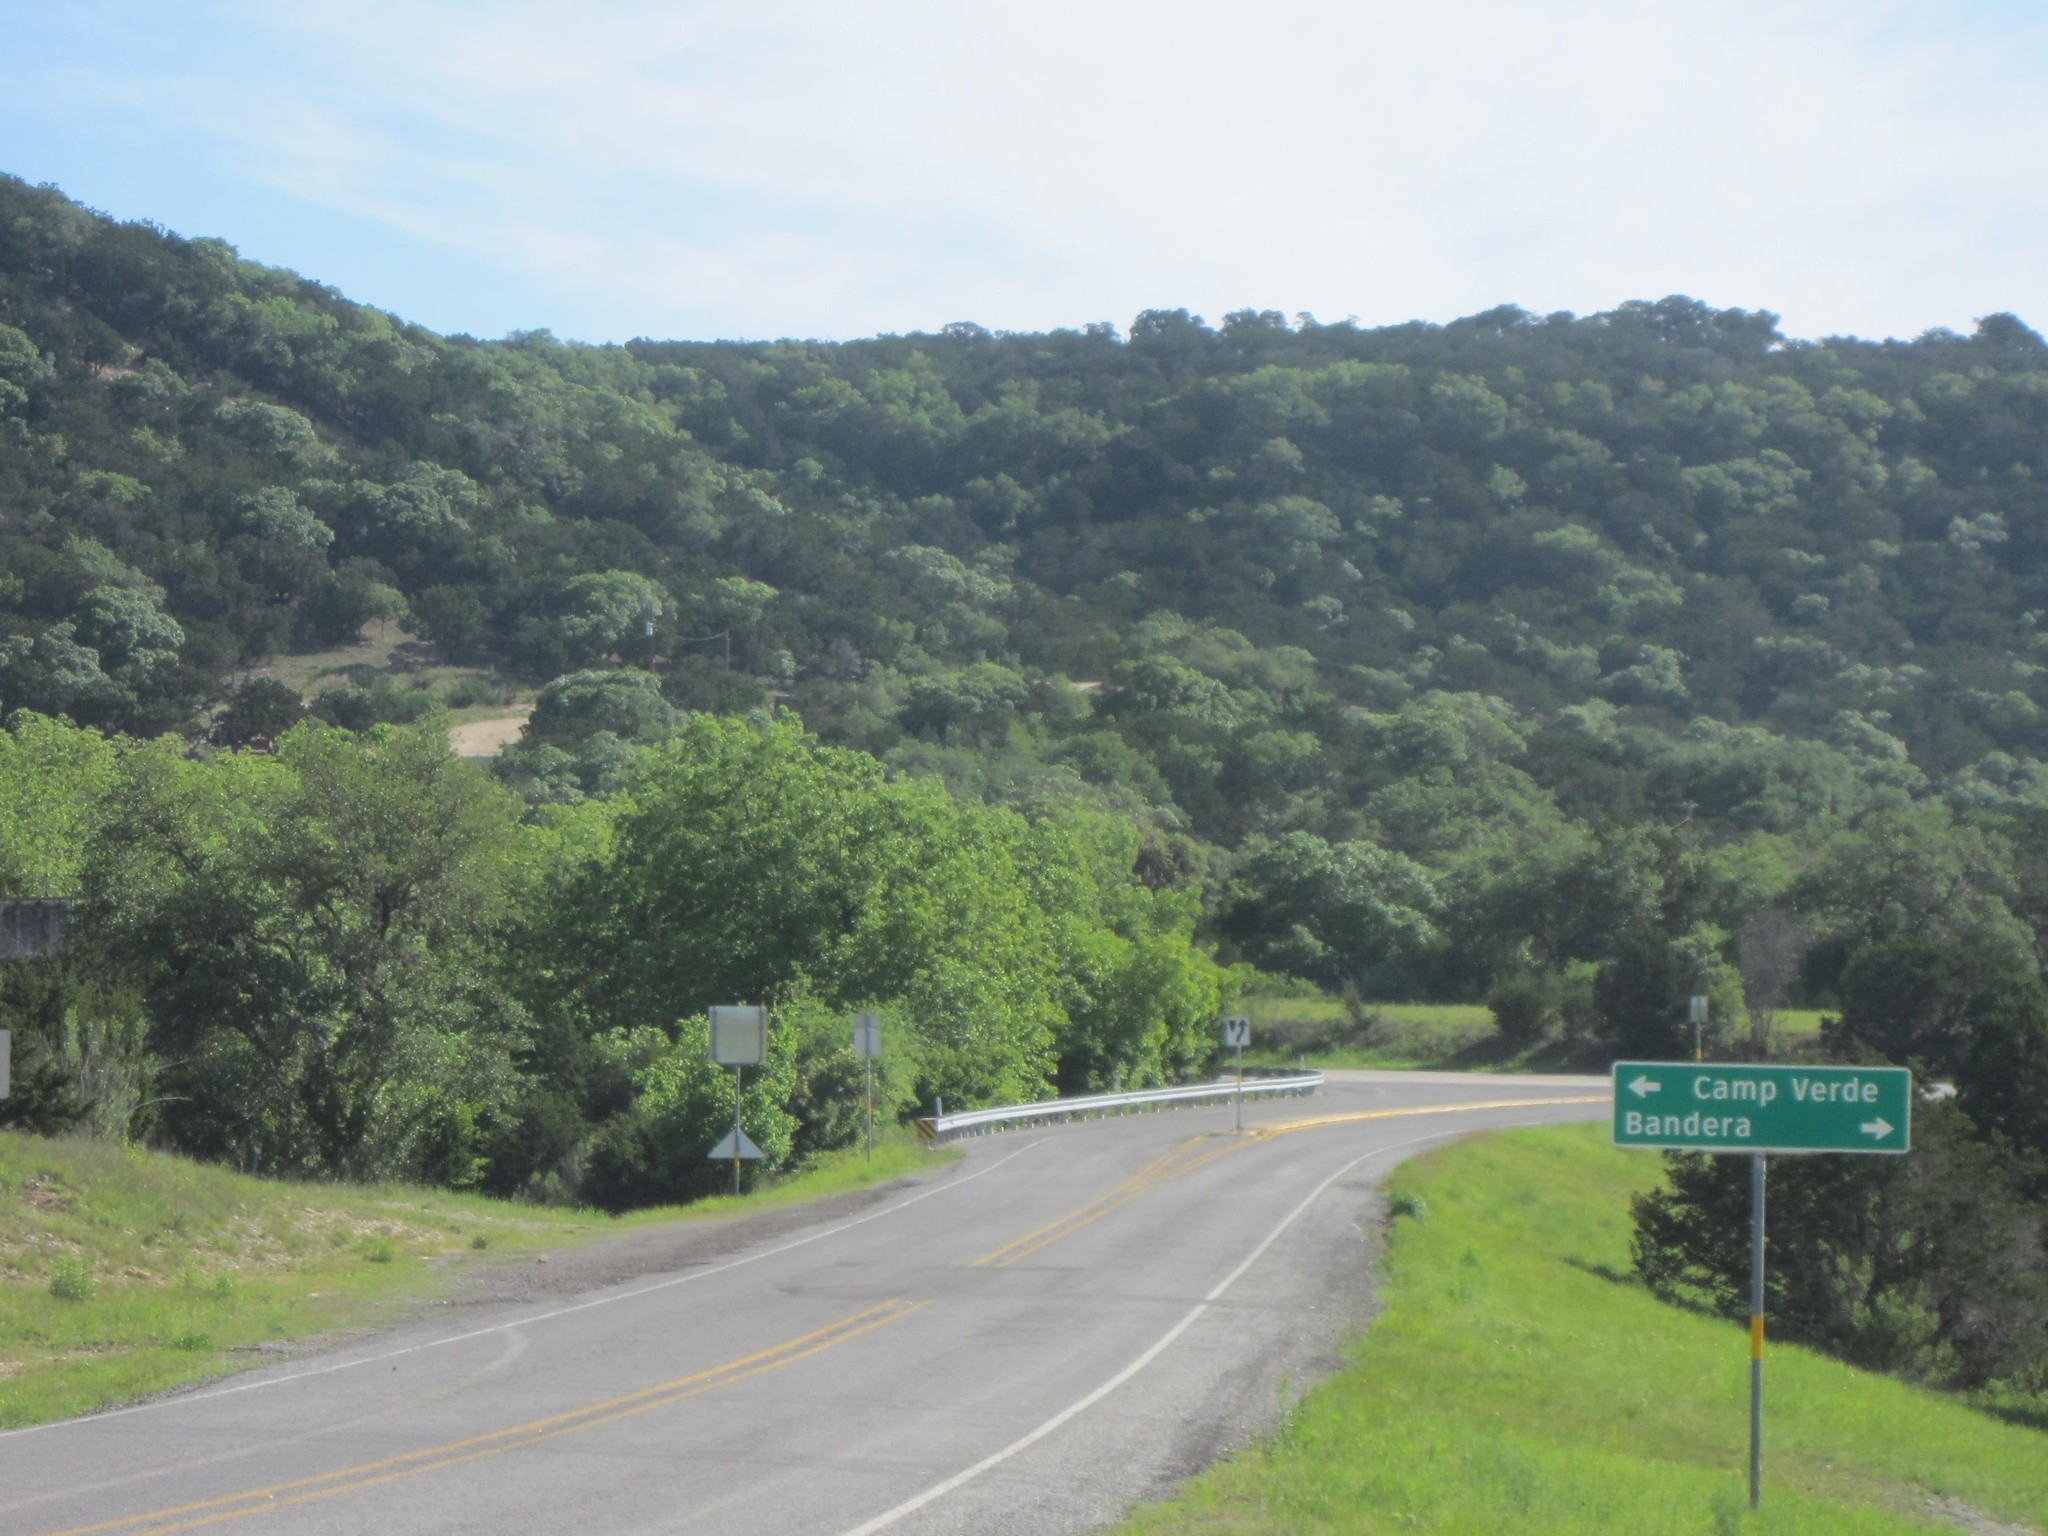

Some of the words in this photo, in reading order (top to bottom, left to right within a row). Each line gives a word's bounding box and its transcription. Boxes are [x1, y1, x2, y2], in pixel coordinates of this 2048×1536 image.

[1694, 1076, 1777, 1107] Camp
[1792, 1077, 1878, 1103] Verde
[1626, 1111, 1752, 1138] Bandera
